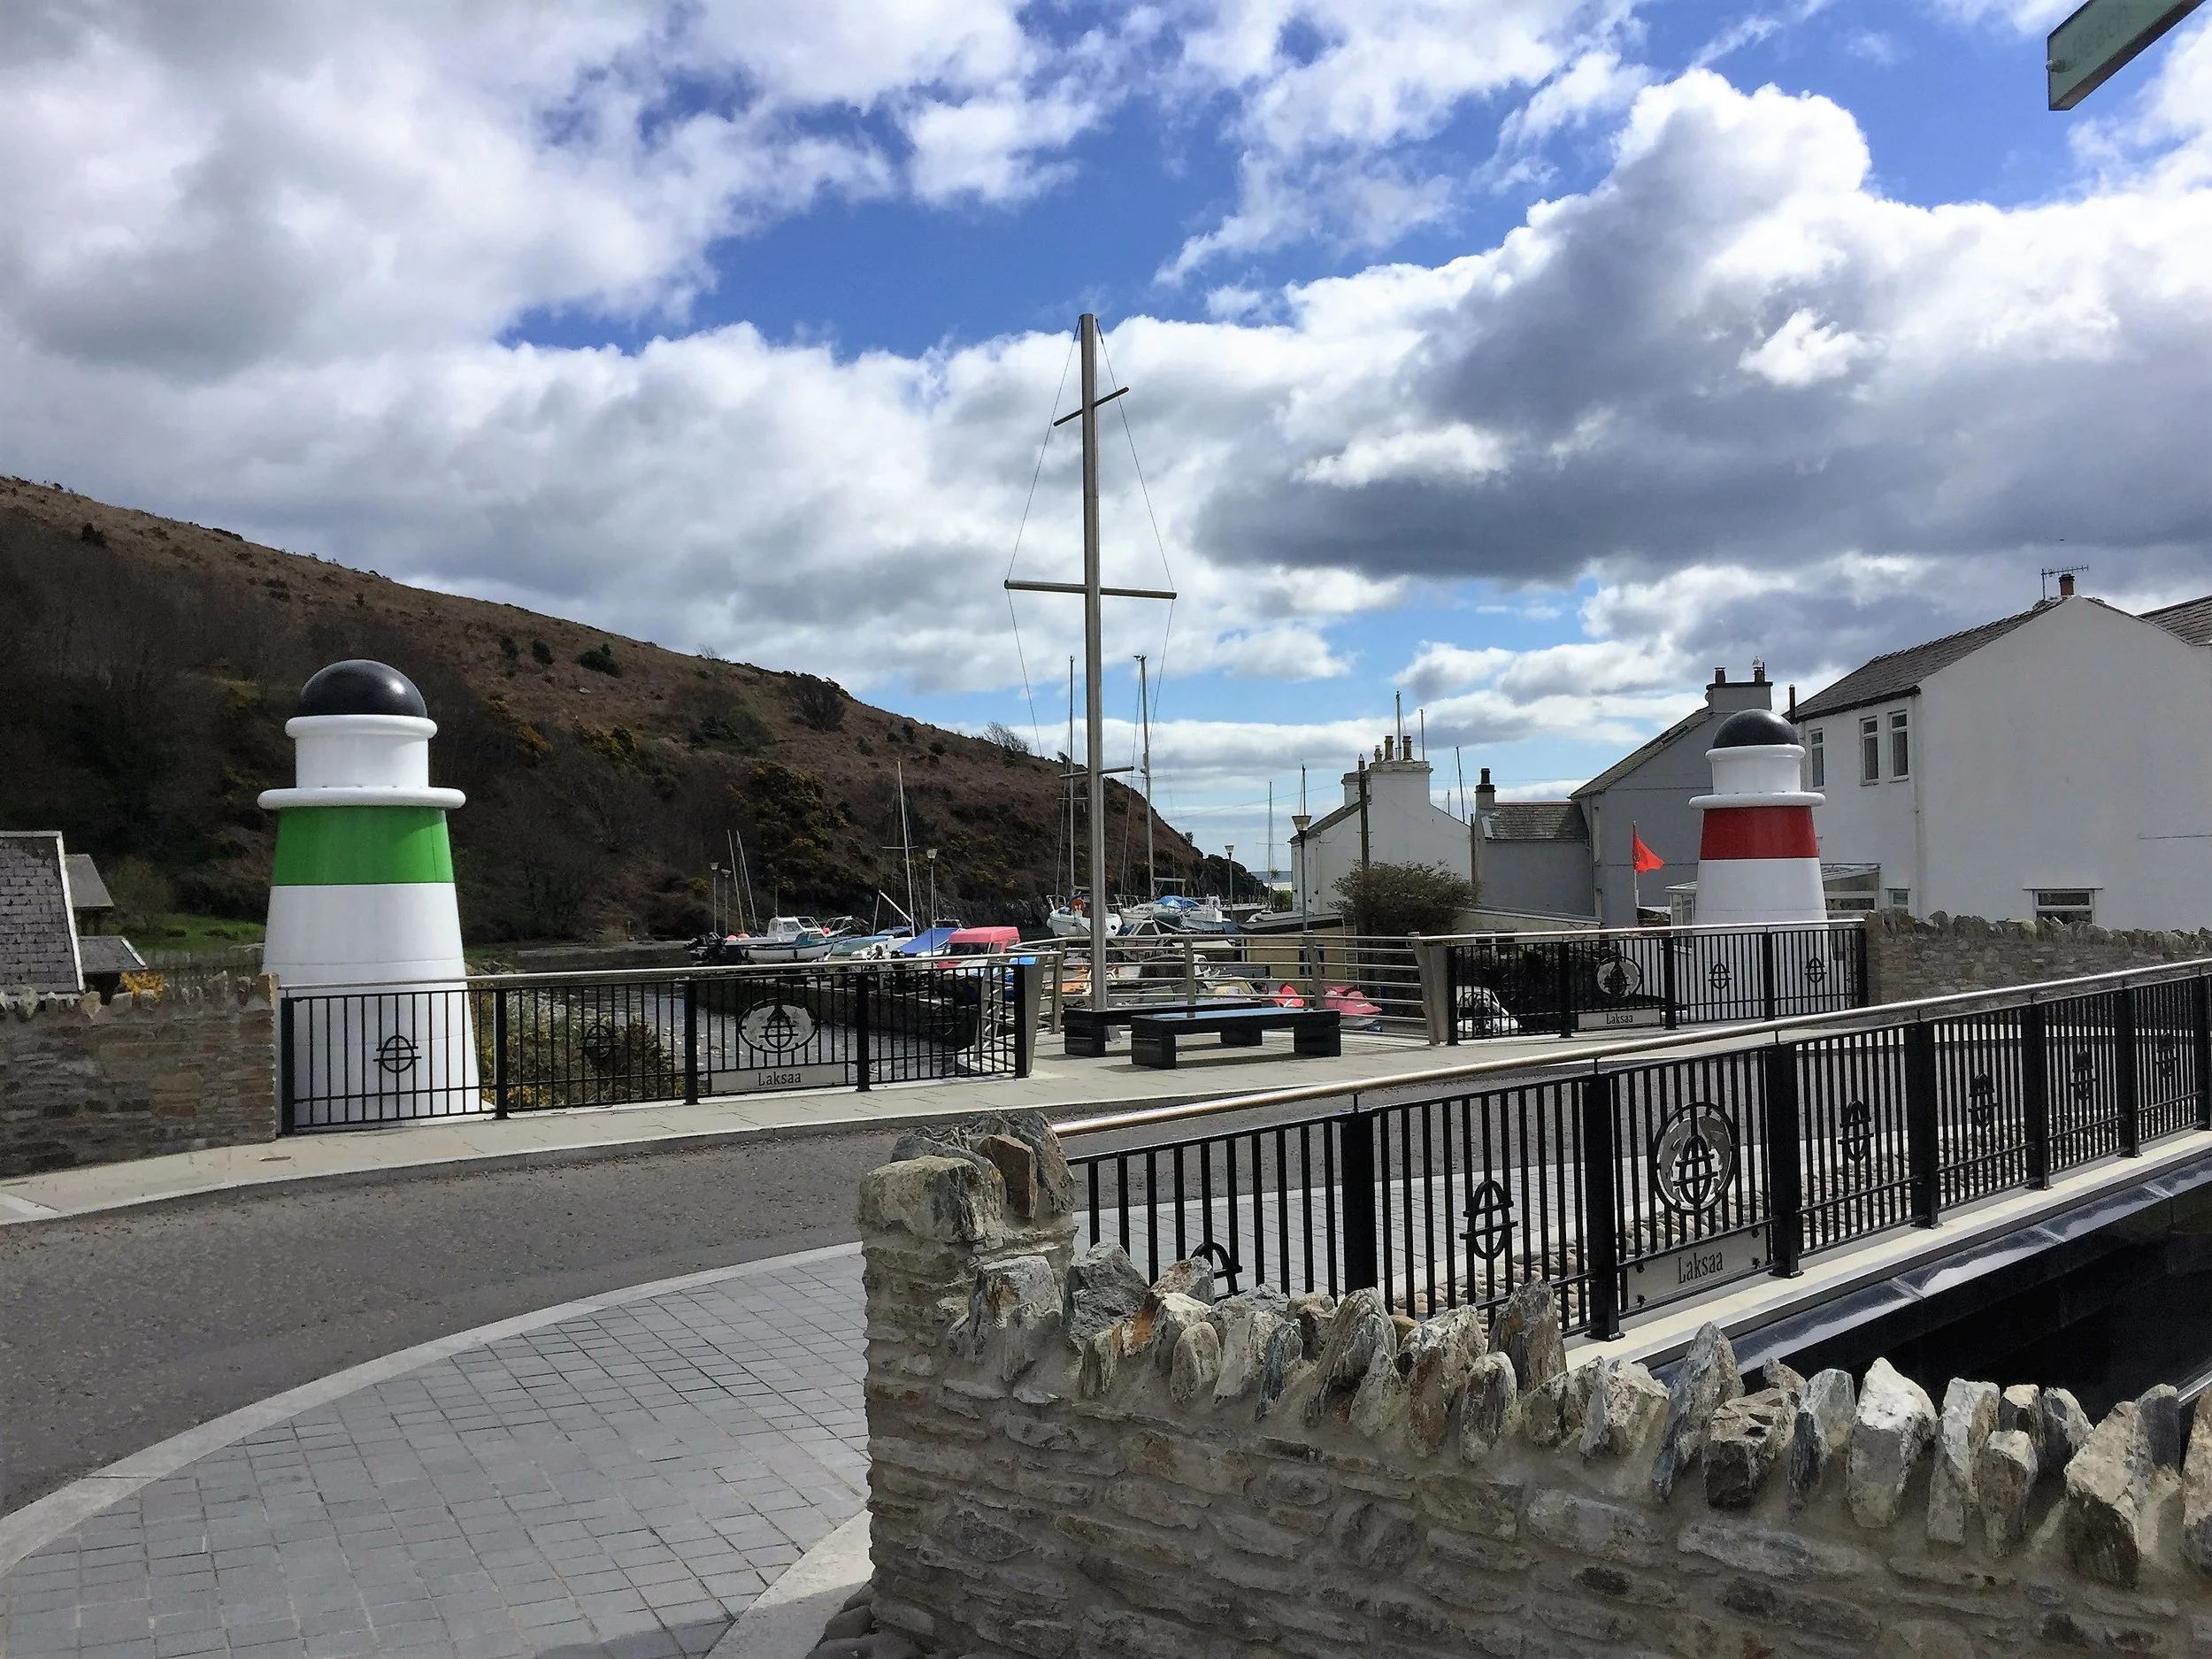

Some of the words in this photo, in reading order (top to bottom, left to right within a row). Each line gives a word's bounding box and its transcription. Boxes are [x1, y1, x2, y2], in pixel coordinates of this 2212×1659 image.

[1607, 1013, 1633, 1025] Laksaa
[757, 1071, 801, 1086] Laksaa
[1678, 1252, 1724, 1284] Laksaa
